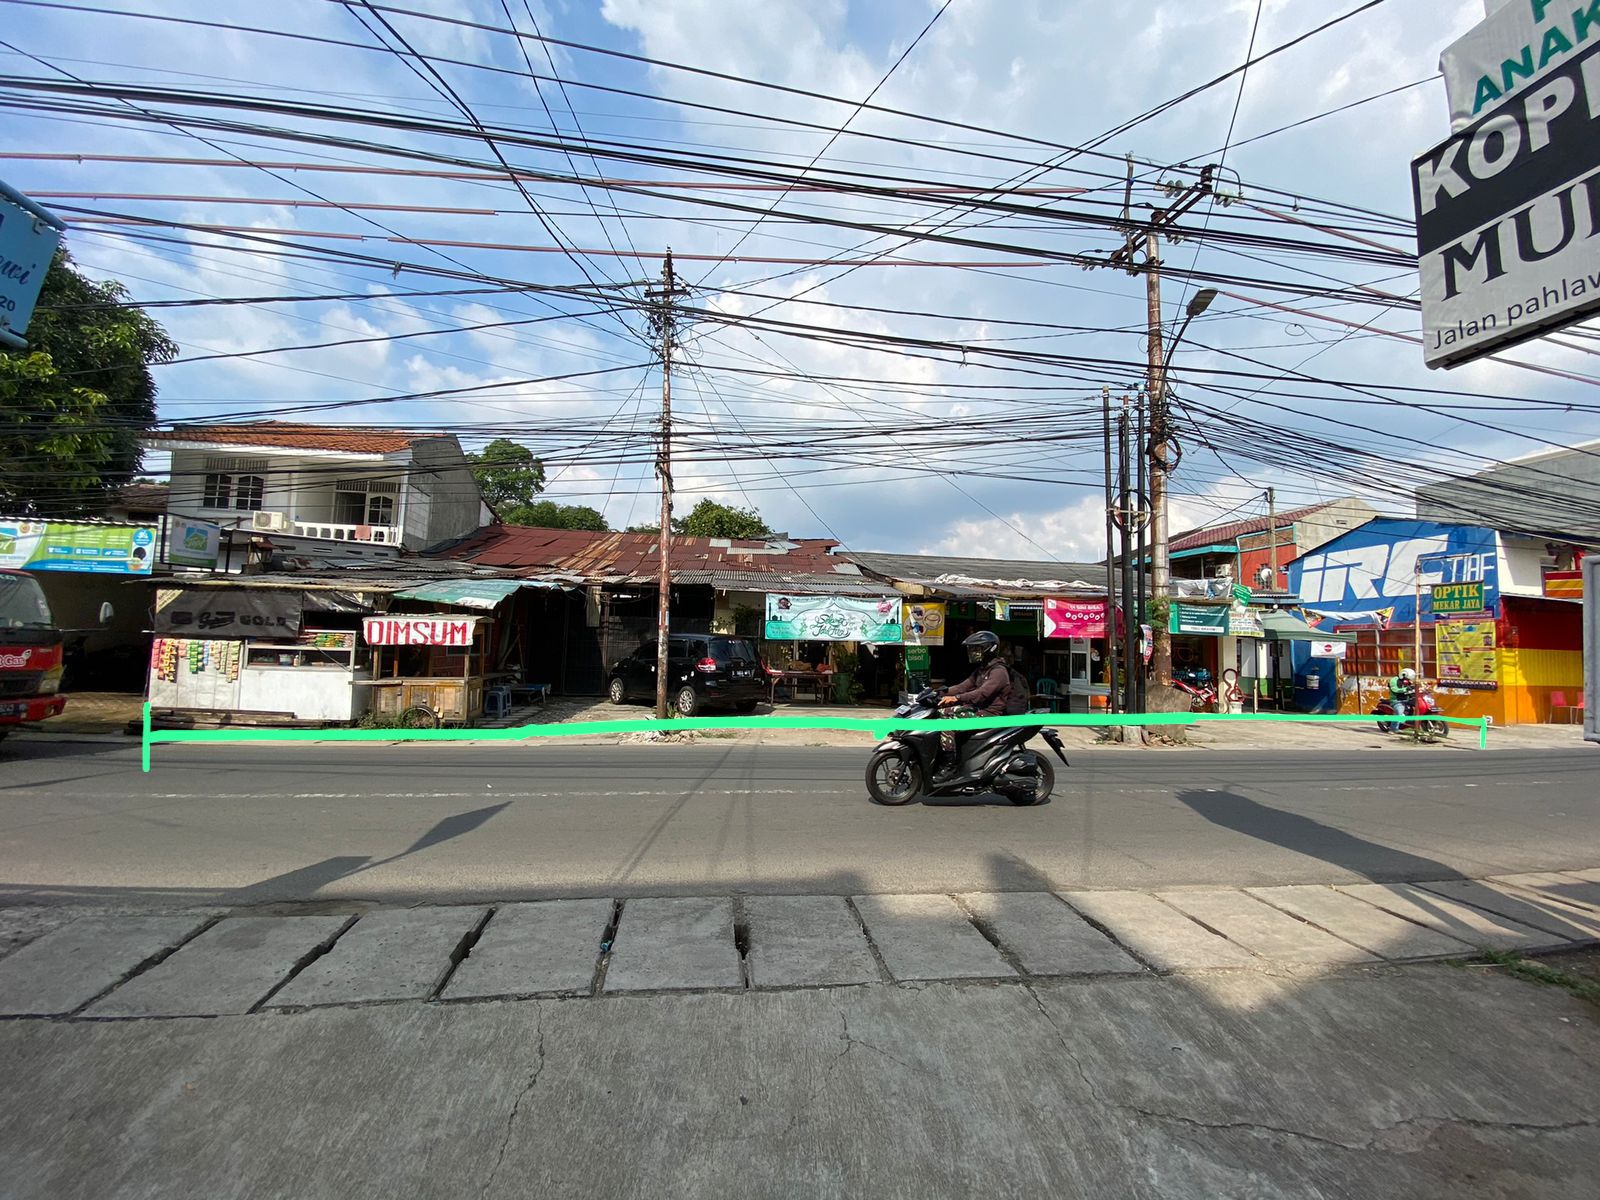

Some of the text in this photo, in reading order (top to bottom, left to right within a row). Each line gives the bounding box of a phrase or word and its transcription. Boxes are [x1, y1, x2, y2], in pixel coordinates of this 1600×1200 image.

[1434, 313, 1497, 349] Jalan
[1433, 584, 1480, 599] OPTIK
[1433, 599, 1481, 610] MEKAR JAYA
[240, 615, 287, 626] GOLD
[367, 620, 467, 645] DIMSUM
[4, 655, 25, 666] Gas
